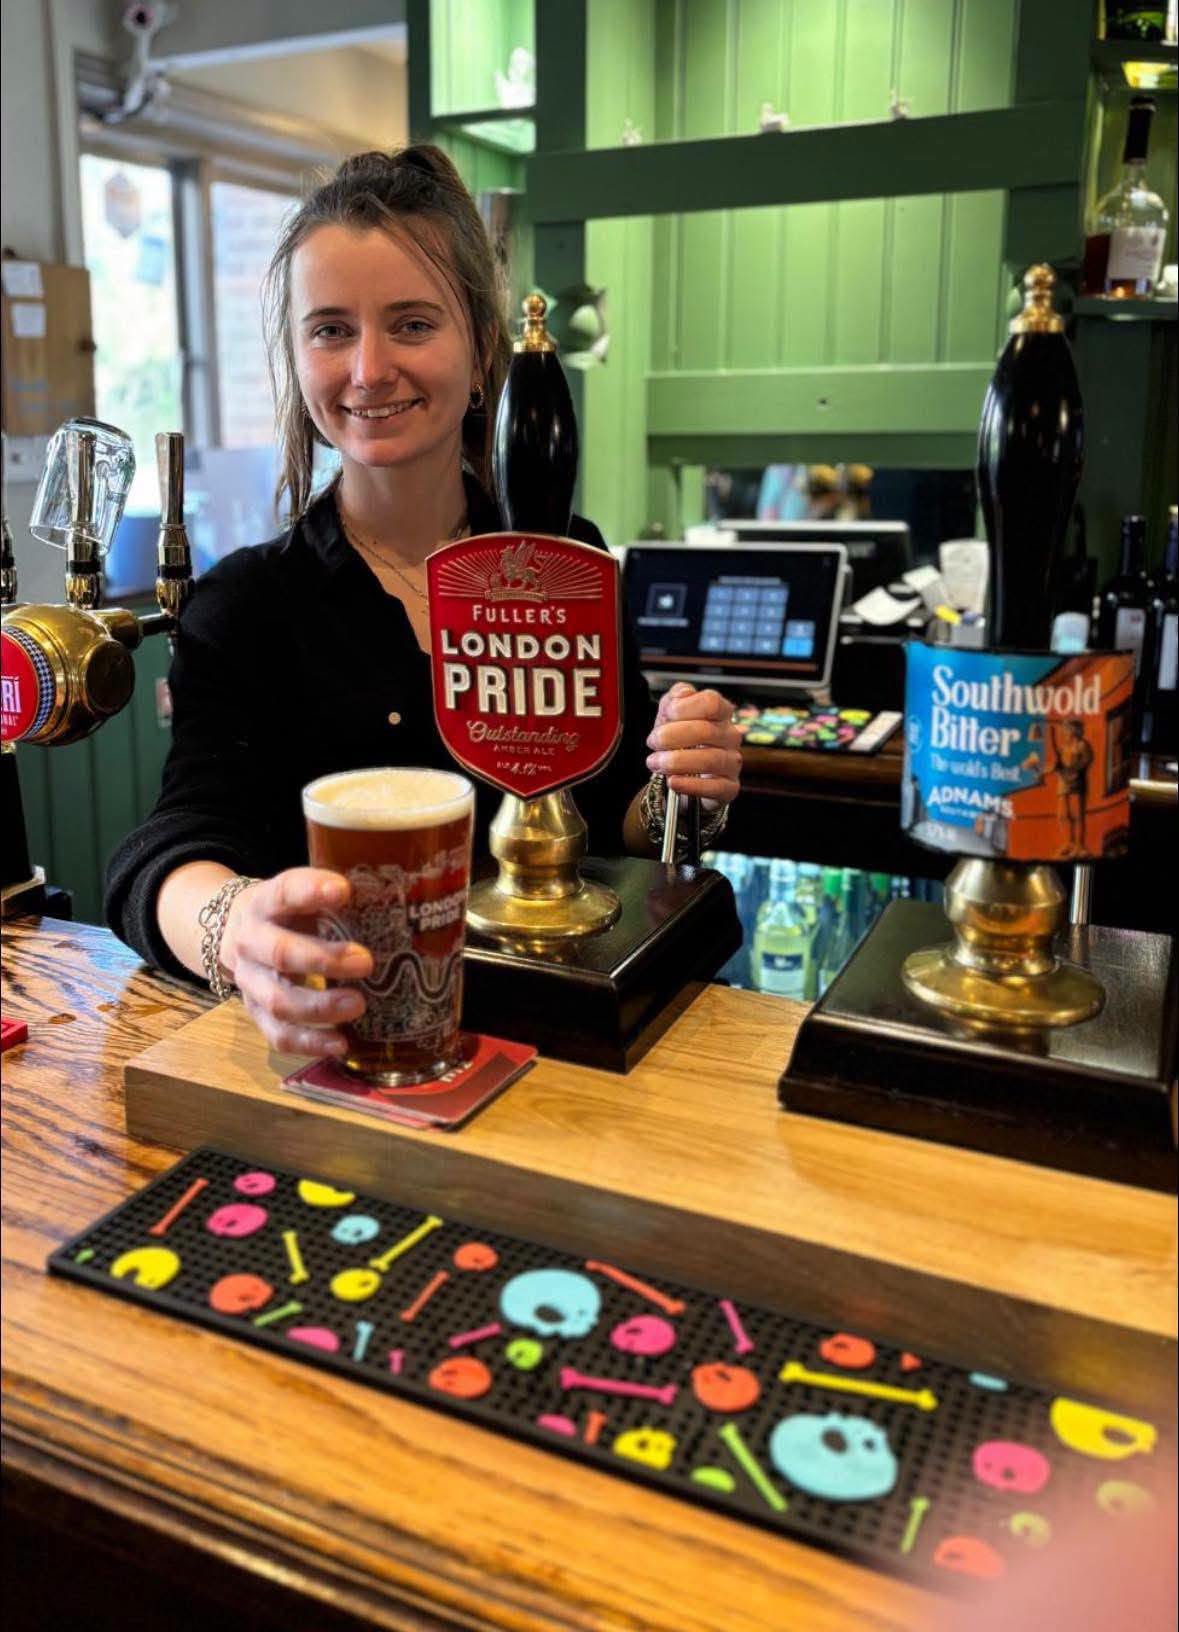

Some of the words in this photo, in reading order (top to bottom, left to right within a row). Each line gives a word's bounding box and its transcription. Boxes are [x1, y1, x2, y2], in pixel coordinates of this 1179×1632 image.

[472, 604, 567, 624] FULLER'S
[440, 629, 601, 660] LONDON
[443, 662, 602, 717] PRIDE
[931, 664, 1101, 715] Southwold
[466, 720, 578, 752] Outstanding
[931, 706, 1020, 756] Bitter
[927, 786, 1013, 818] ADNAMS
